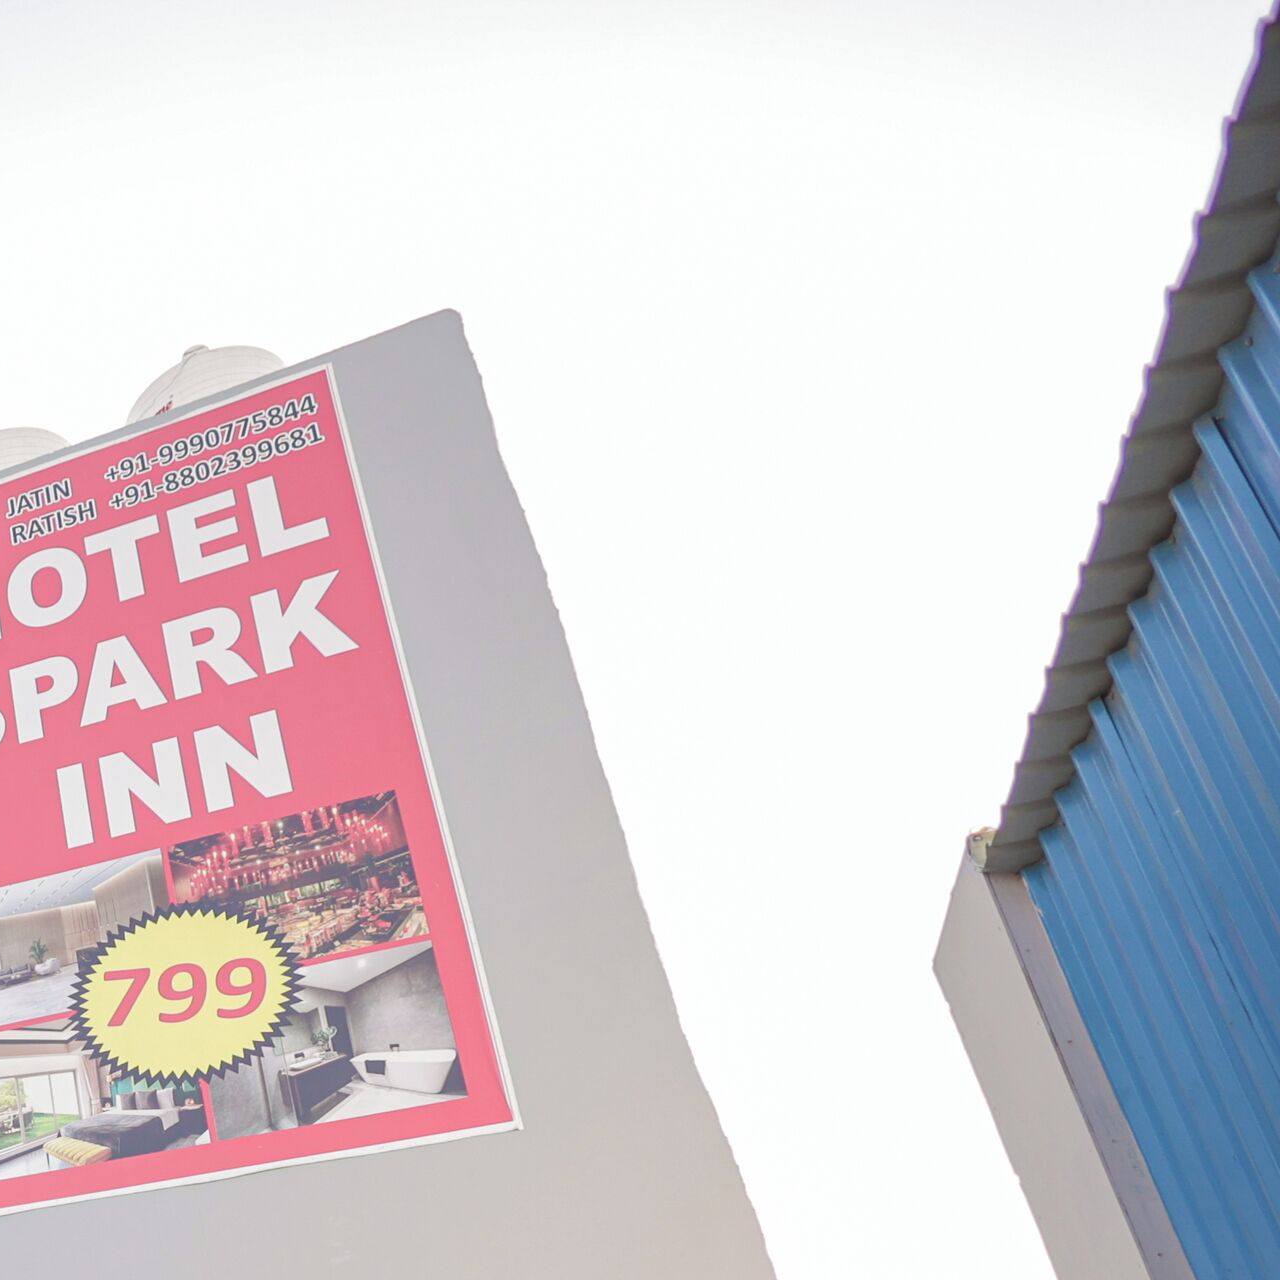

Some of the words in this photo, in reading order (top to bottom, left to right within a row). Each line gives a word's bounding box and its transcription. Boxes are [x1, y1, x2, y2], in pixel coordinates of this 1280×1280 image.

[5, 478, 73, 519] JATIN
[104, 394, 319, 483] +91-9990775844
[10, 499, 98, 546] RATISH
[109, 423, 325, 511] +91-8802399681
[55, 709, 294, 850] INN
[103, 957, 267, 1027] 799
